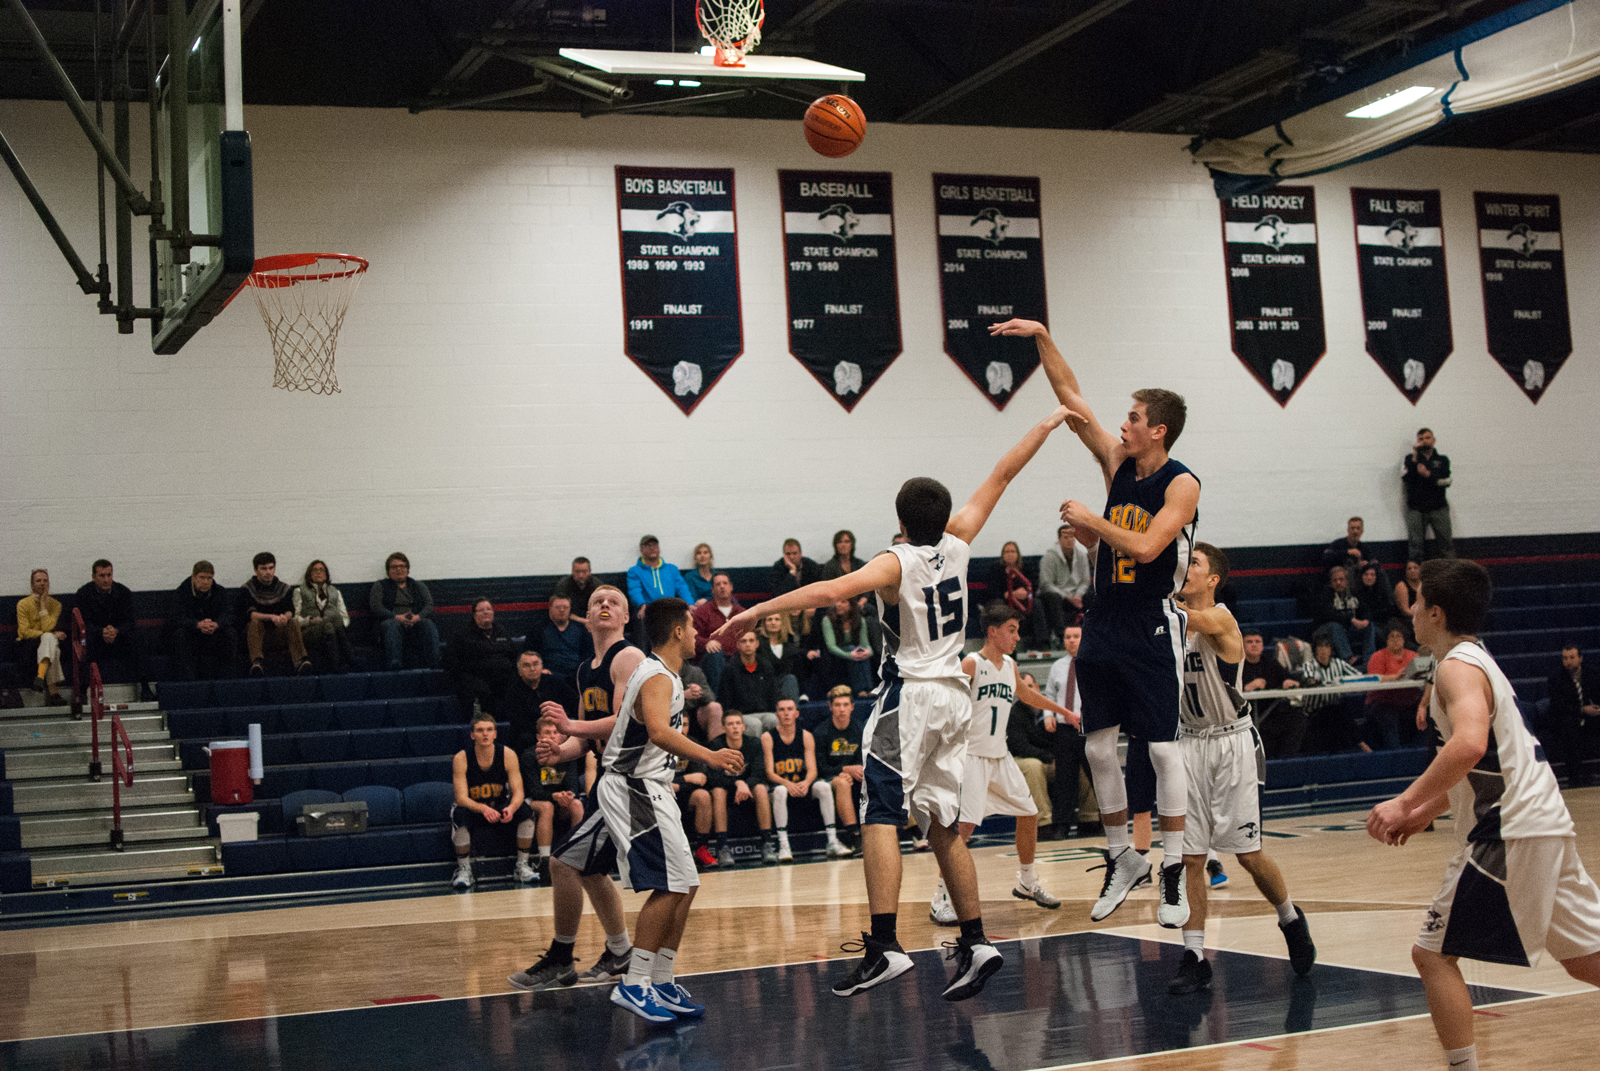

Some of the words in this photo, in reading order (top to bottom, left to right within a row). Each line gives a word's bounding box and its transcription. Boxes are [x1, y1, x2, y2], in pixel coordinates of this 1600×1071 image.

[625, 178, 654, 193] BOYS
[657, 179, 726, 195] BASKETBALL
[800, 182, 873, 198] BASEBALL
[940, 185, 970, 200] GIRLS
[972, 187, 1035, 202] BASKETBALL
[1232, 195, 1260, 208] FIELD
[1262, 195, 1305, 210] HOCKEY
[1369, 199, 1394, 213] FALL
[1396, 200, 1424, 213] SPIRIT
[1484, 203, 1521, 217] WINTER
[1523, 204, 1551, 218] SPIRIT
[640, 244, 669, 255] STATE
[672, 244, 719, 256] CHAMPION
[803, 246, 830, 257] STATE
[832, 247, 878, 257] CHAMPION
[956, 248, 982, 259] STATE
[984, 249, 1028, 260] CHAMPION
[626, 259, 650, 270] 1989
[654, 260, 678, 270] 1990
[682, 260, 705, 270] 1993
[1241, 253, 1264, 264] STATE
[1265, 254, 1306, 265] CHAMPION
[1373, 256, 1395, 267] STATE
[1396, 257, 1433, 267] CHAMPION
[1495, 259, 1515, 269] STATE
[1516, 261, 1552, 270] CHAMPION
[790, 261, 813, 271] 1979
[663, 304, 703, 315] FINALIST
[824, 304, 863, 314] FINALIST
[977, 305, 1014, 315] FINALIST
[1261, 307, 1294, 317] FINALIST
[1392, 308, 1422, 318] FINALIST
[1513, 309, 1542, 319] FINALIST
[629, 319, 654, 330] 1991
[792, 319, 815, 329] 1977
[921, 575, 963, 642] 15
[990, 705, 998, 736] 1
[707, 845, 760, 856] SHOOL
